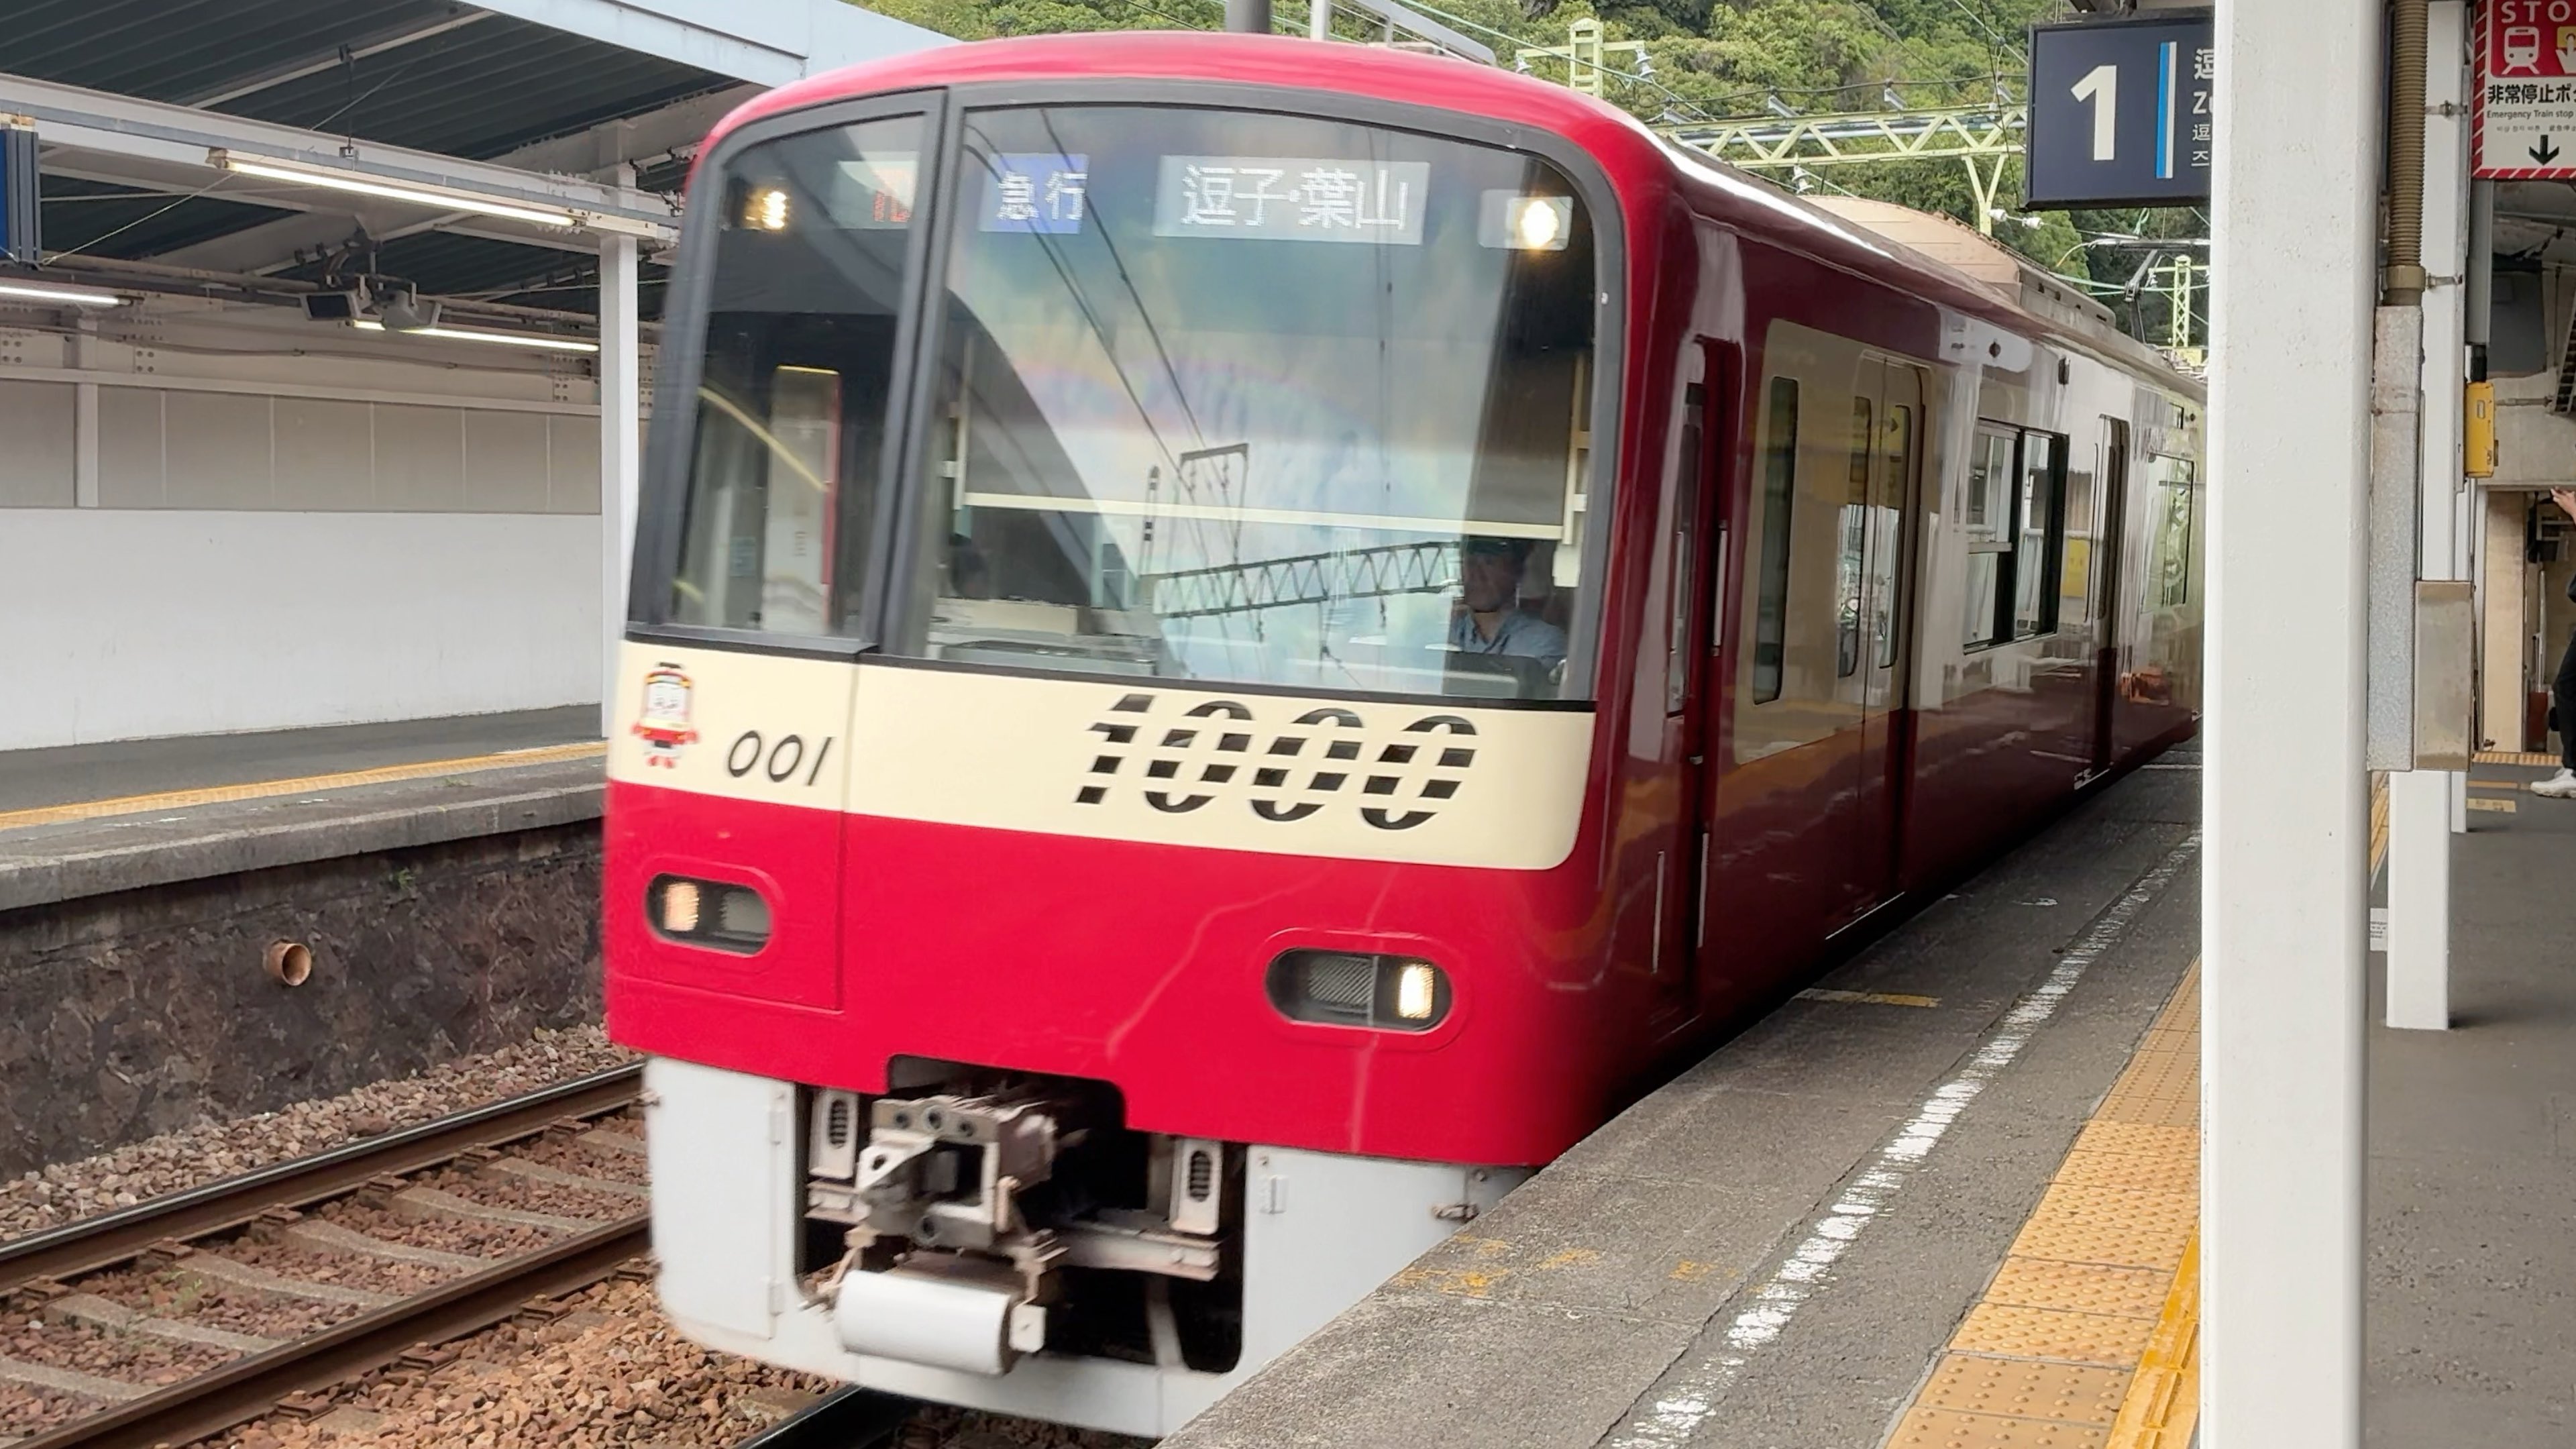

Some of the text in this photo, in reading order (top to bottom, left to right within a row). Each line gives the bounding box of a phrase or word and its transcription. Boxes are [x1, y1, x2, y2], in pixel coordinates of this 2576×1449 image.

[2501, 1, 2571, 23] STO
[2070, 65, 2117, 160] 1
[2487, 83, 2576, 105] 非常停止ボ
[2487, 109, 2574, 120] Emergency Train stop
[996, 170, 1088, 221] 急行
[728, 730, 833, 786] 001
[1075, 694, 1479, 830] 1000
